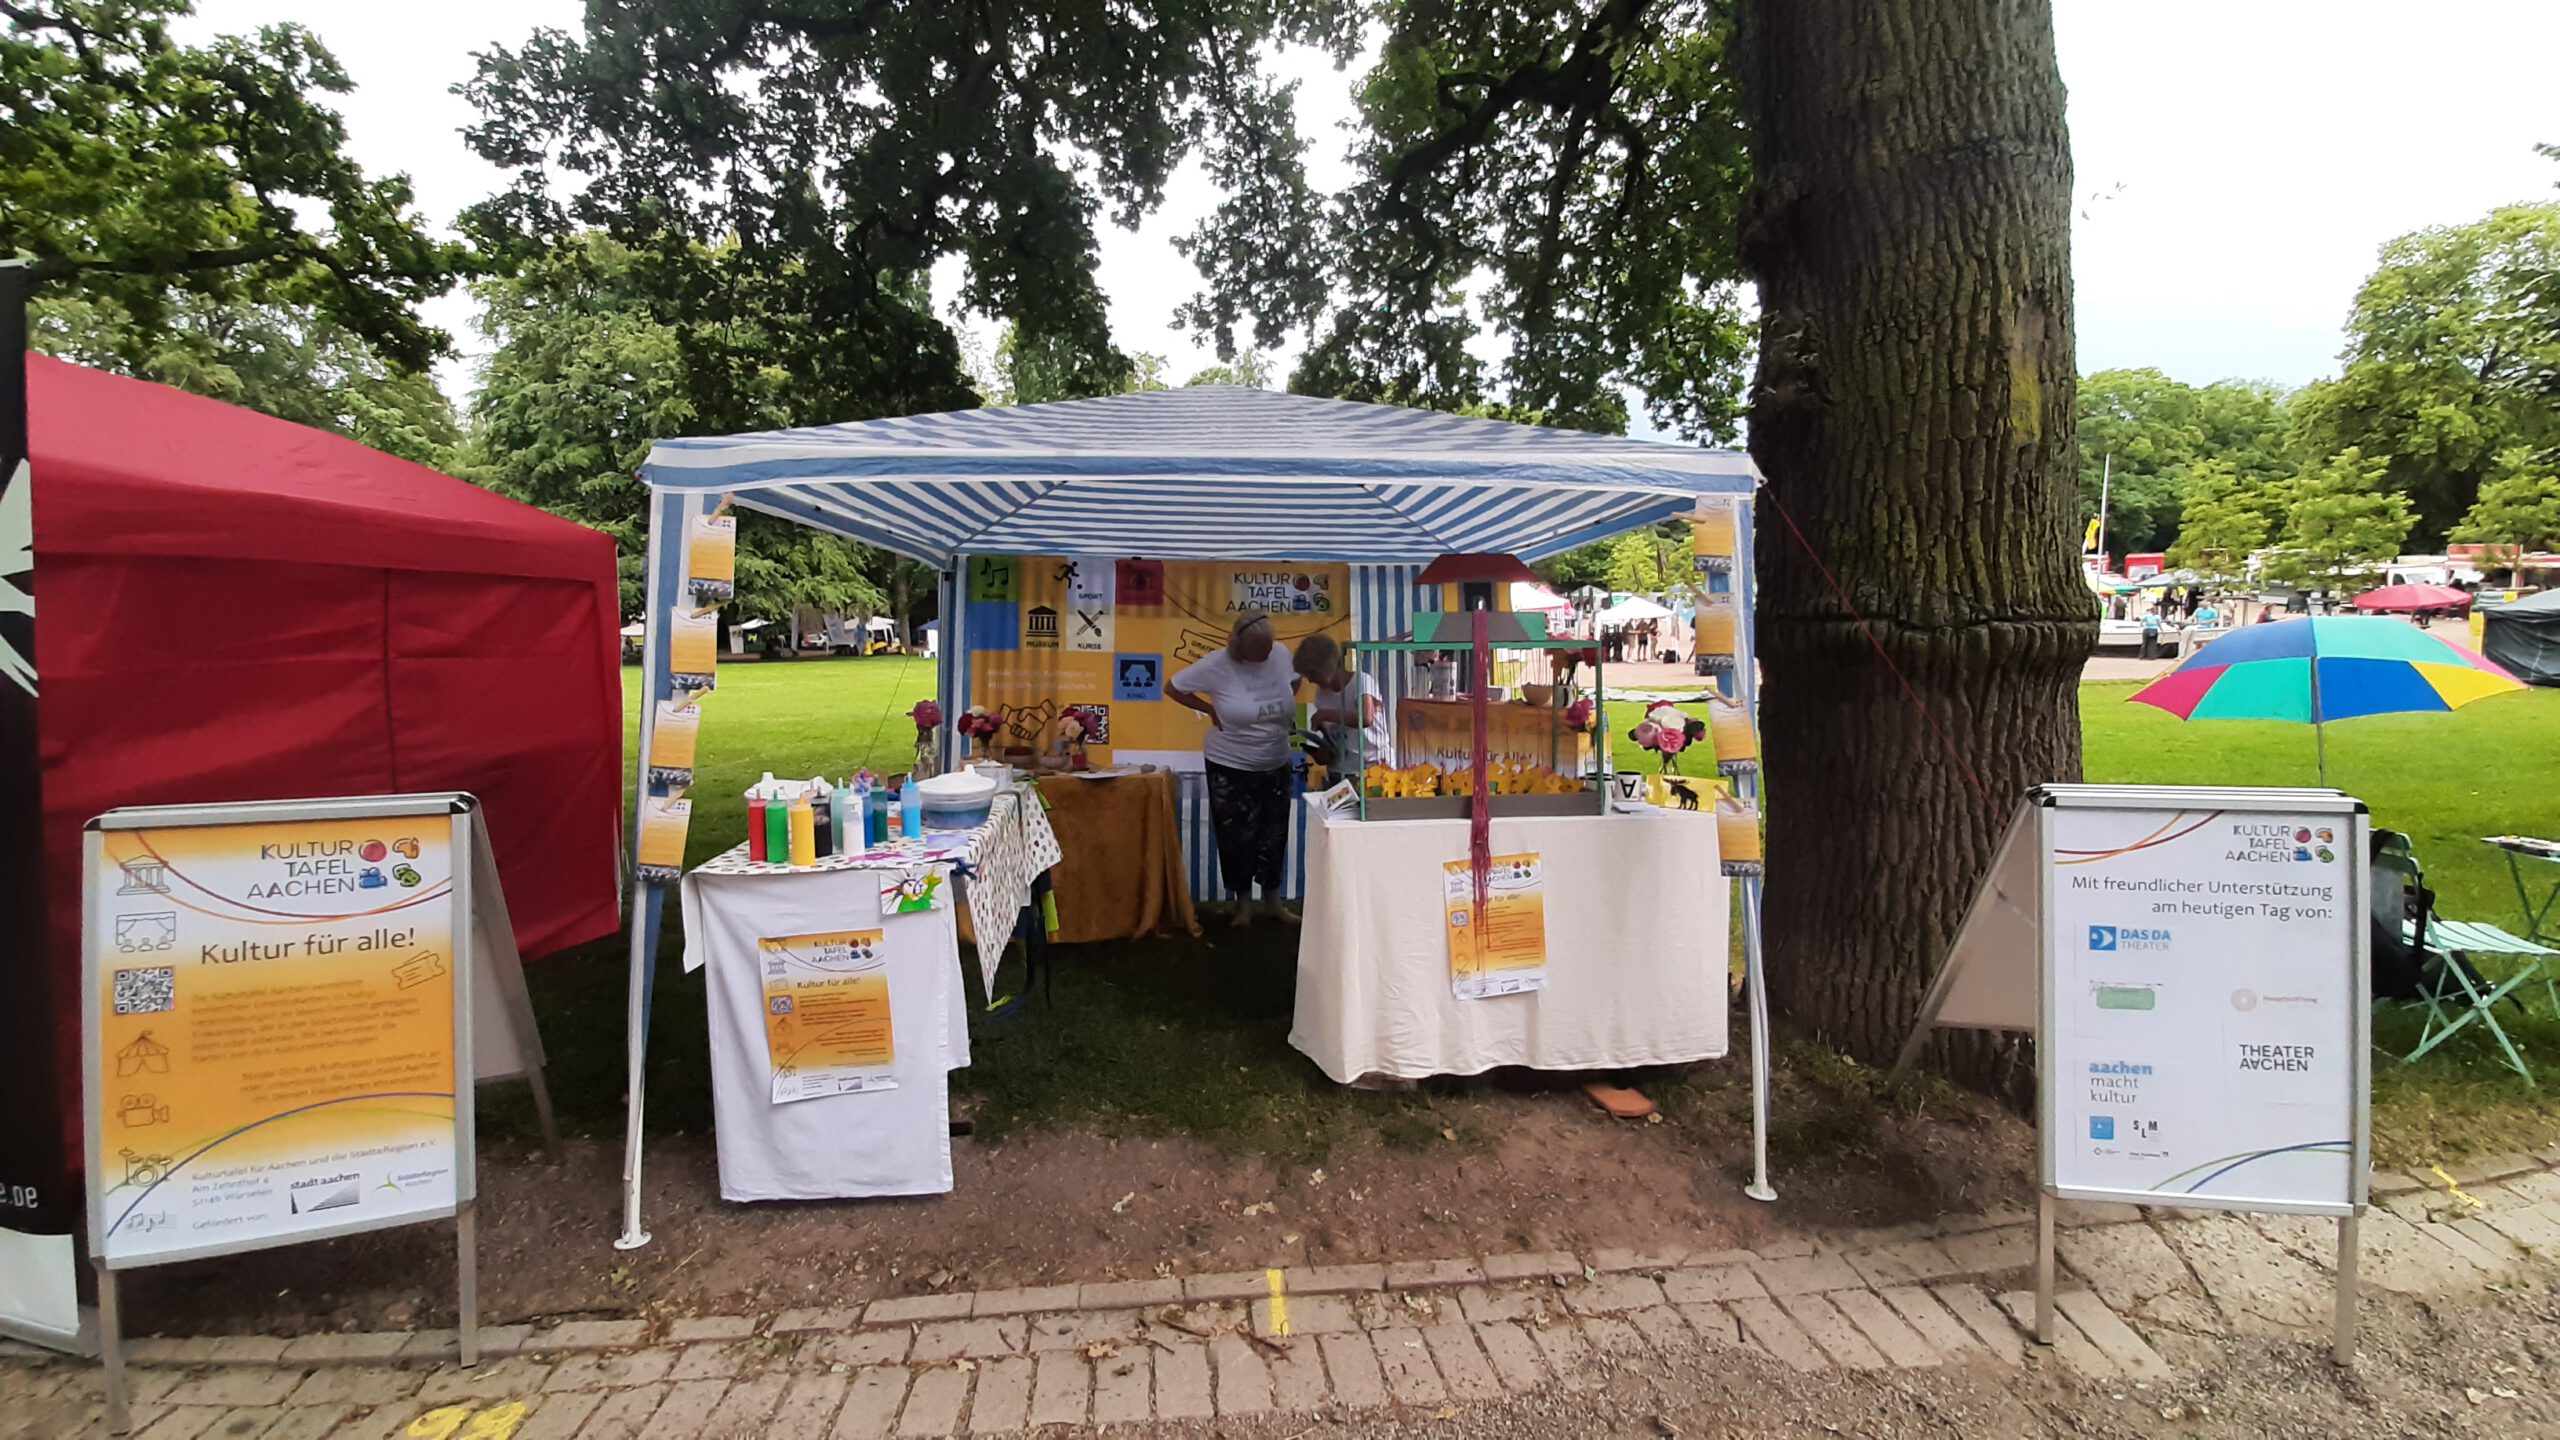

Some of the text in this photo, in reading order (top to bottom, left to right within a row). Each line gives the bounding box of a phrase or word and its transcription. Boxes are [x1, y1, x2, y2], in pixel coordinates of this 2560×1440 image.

[1234, 572, 1290, 585] KULTUR
[1248, 586, 1290, 598] TAFEL
[1225, 600, 1290, 613] AACHEN
[1436, 746, 1472, 760] Kultu
[2233, 825, 2290, 836] KULTUR
[261, 840, 354, 860] KULTUR
[2249, 838, 2290, 850] TAFEL
[2225, 850, 2291, 862] AACHEN
[285, 859, 354, 877] TAFEL
[247, 877, 355, 899] AACHEN
[2072, 876, 2333, 901] Mit freundlicher Unterstützung
[2152, 900, 2332, 921] am heutigen Tag von:
[2121, 929, 2171, 940] DAS DA
[201, 927, 415, 965] Kultur für alle!
[814, 939, 847, 948] KULTUR
[2121, 941, 2170, 951] THEATER
[812, 954, 849, 963] AACHEN
[797, 981, 825, 989] Kultur
[2239, 1044, 2314, 1059] THEATER
[2089, 1060, 2153, 1076] aachen
[2090, 1075, 2139, 1088] macht
[2090, 1089, 2137, 1104] kultur
[267, 1158, 307, 1172] Aachen
[308, 1154, 329, 1166] und
[331, 1151, 347, 1162] die
[290, 1172, 361, 1190] stadt aachen
